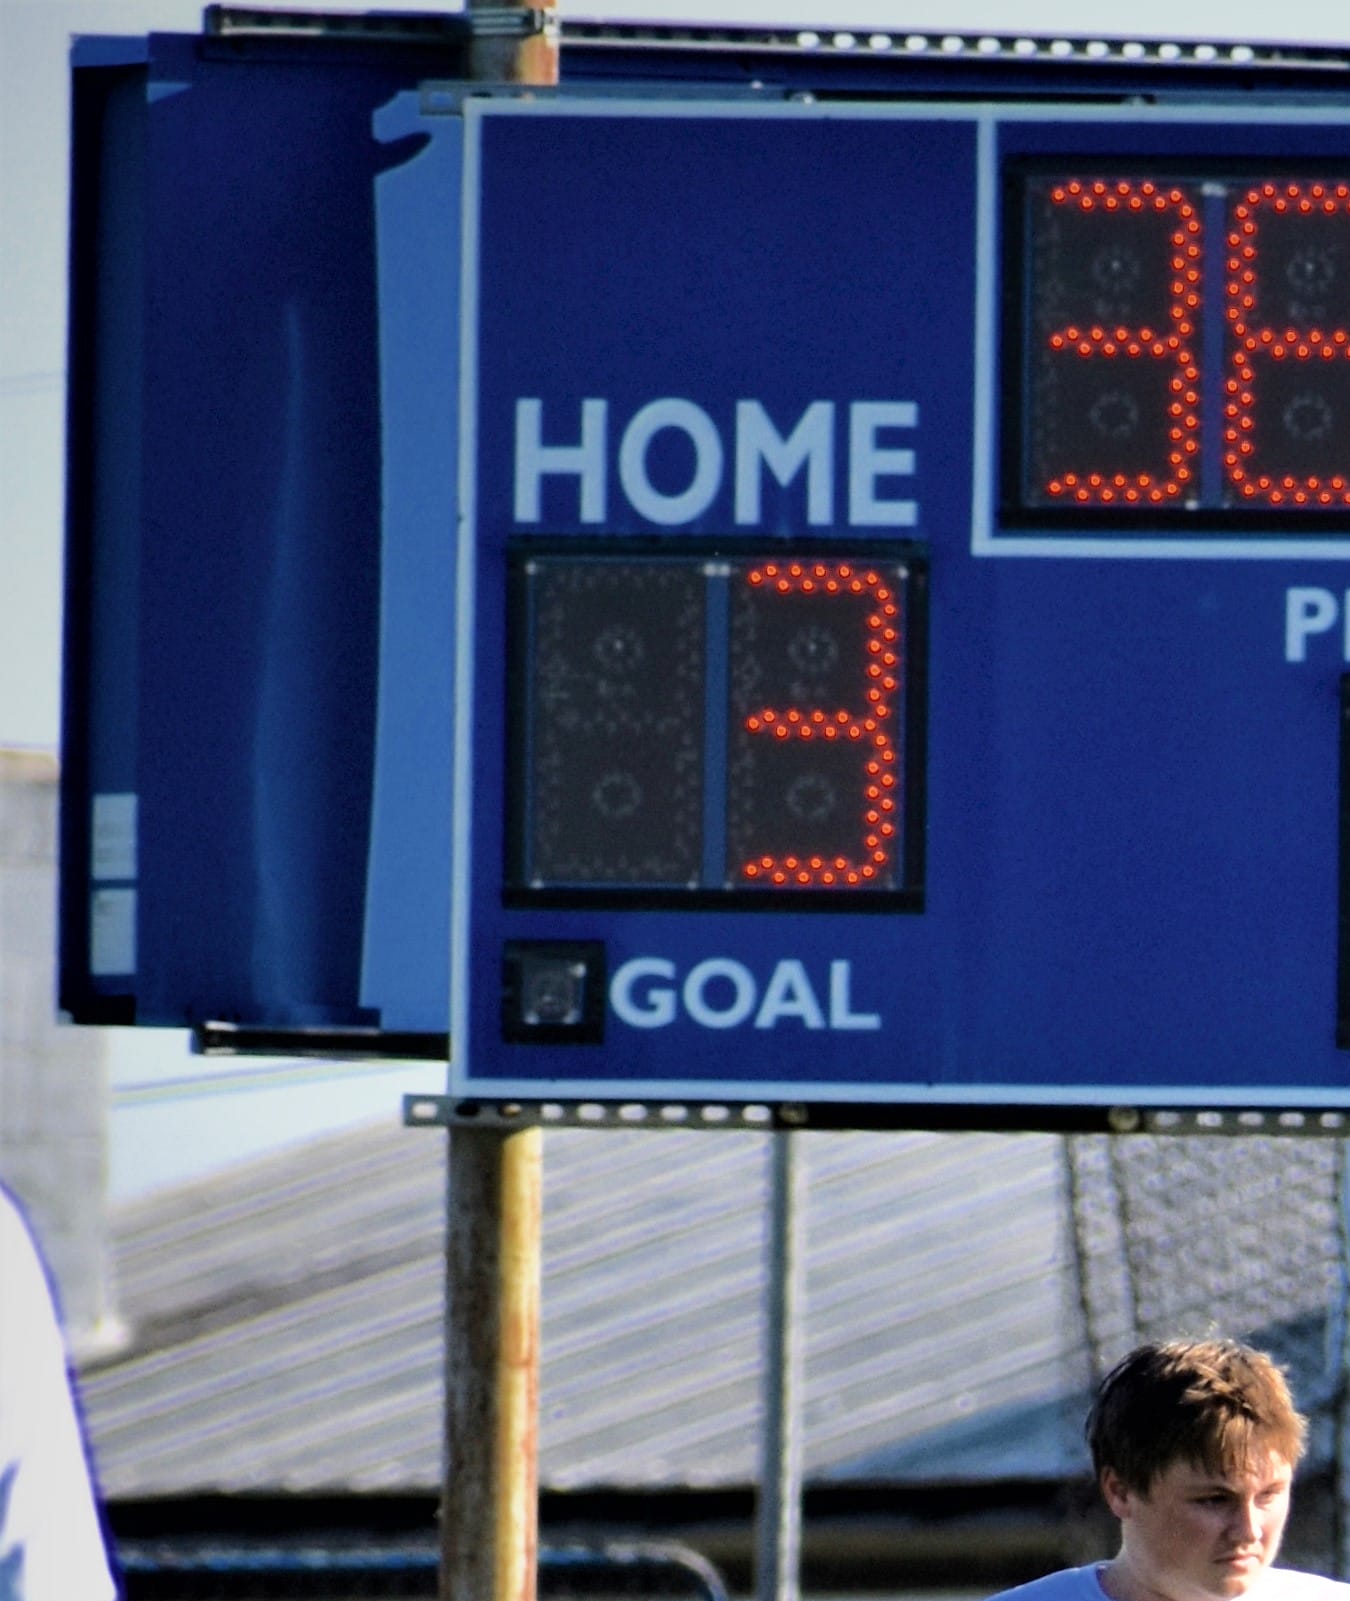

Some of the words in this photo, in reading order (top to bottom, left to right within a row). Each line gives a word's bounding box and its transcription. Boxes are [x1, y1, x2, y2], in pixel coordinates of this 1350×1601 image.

[513, 397, 918, 526] HOME
[743, 562, 898, 887] 3
[608, 957, 881, 1030] GOAL
